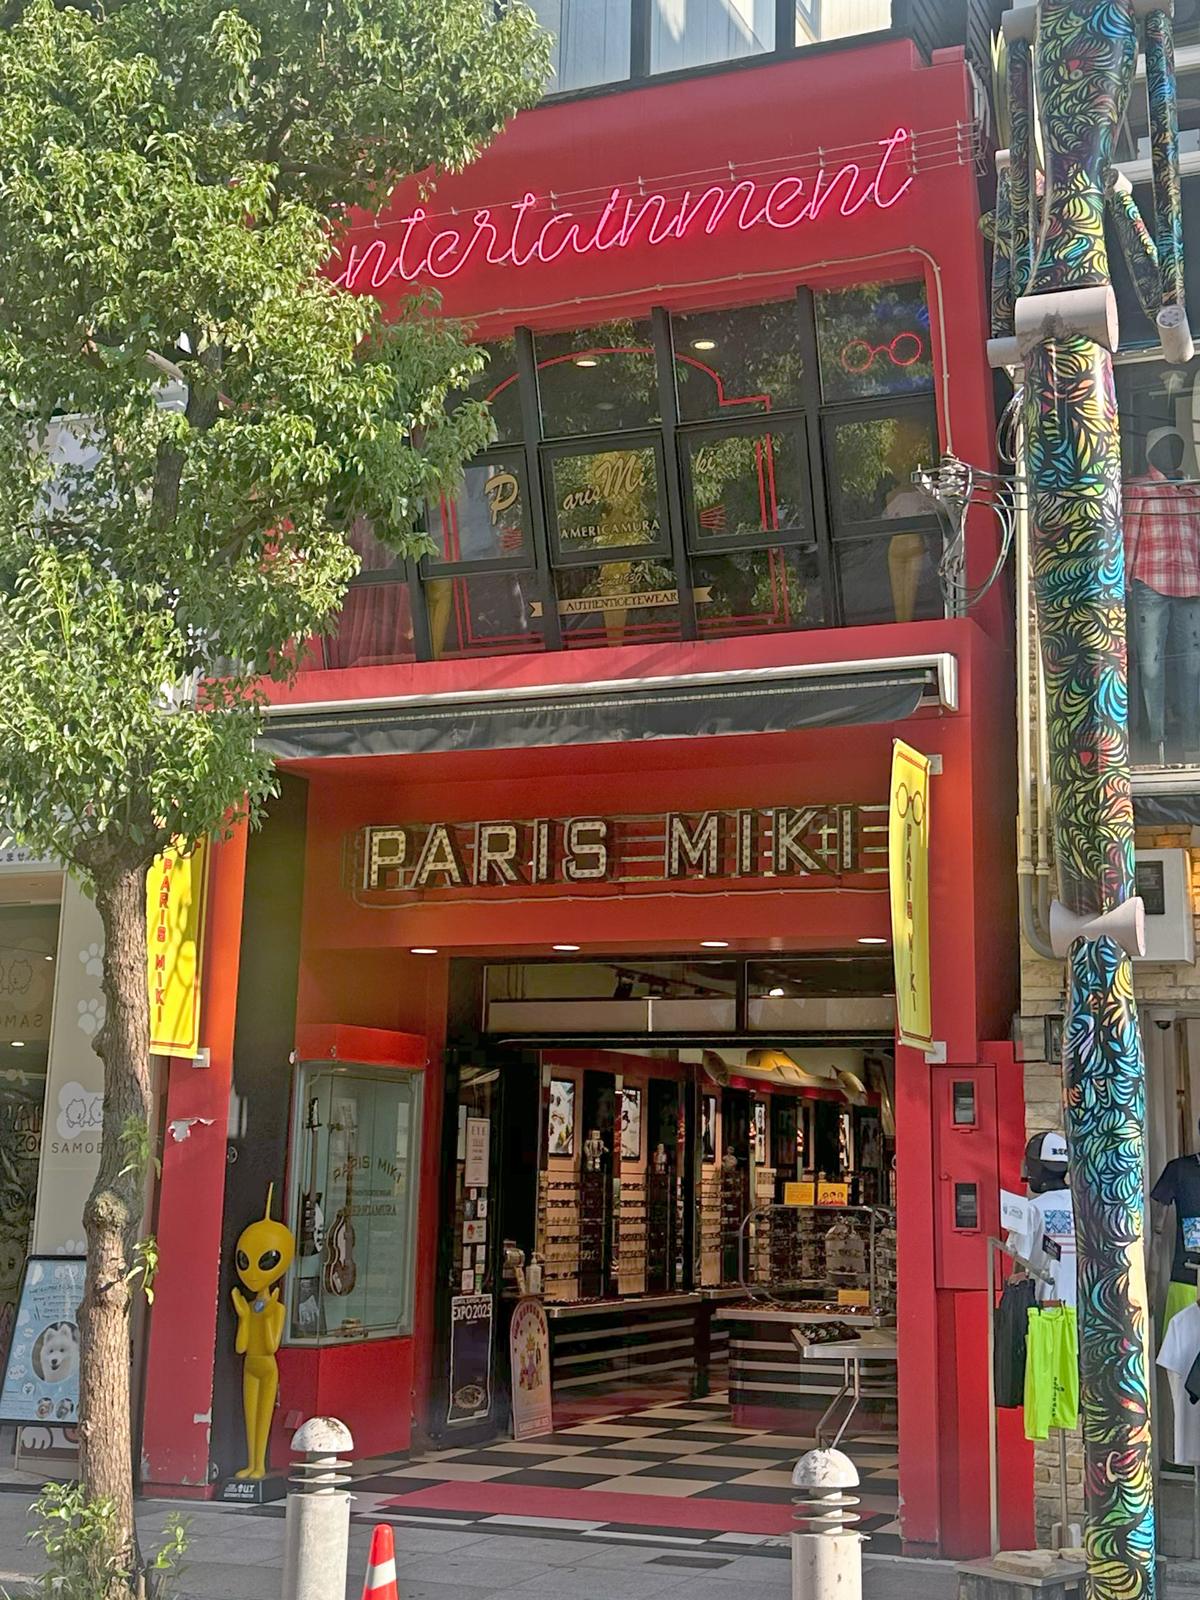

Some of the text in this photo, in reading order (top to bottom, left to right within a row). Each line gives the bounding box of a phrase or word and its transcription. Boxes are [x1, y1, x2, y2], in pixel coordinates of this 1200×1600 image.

[333, 127, 914, 289] ntertainment
[363, 803, 861, 890] PARIS MIKI
[905, 823, 914, 920] PARIS
[155, 858, 173, 1023] PARIS MIKI
